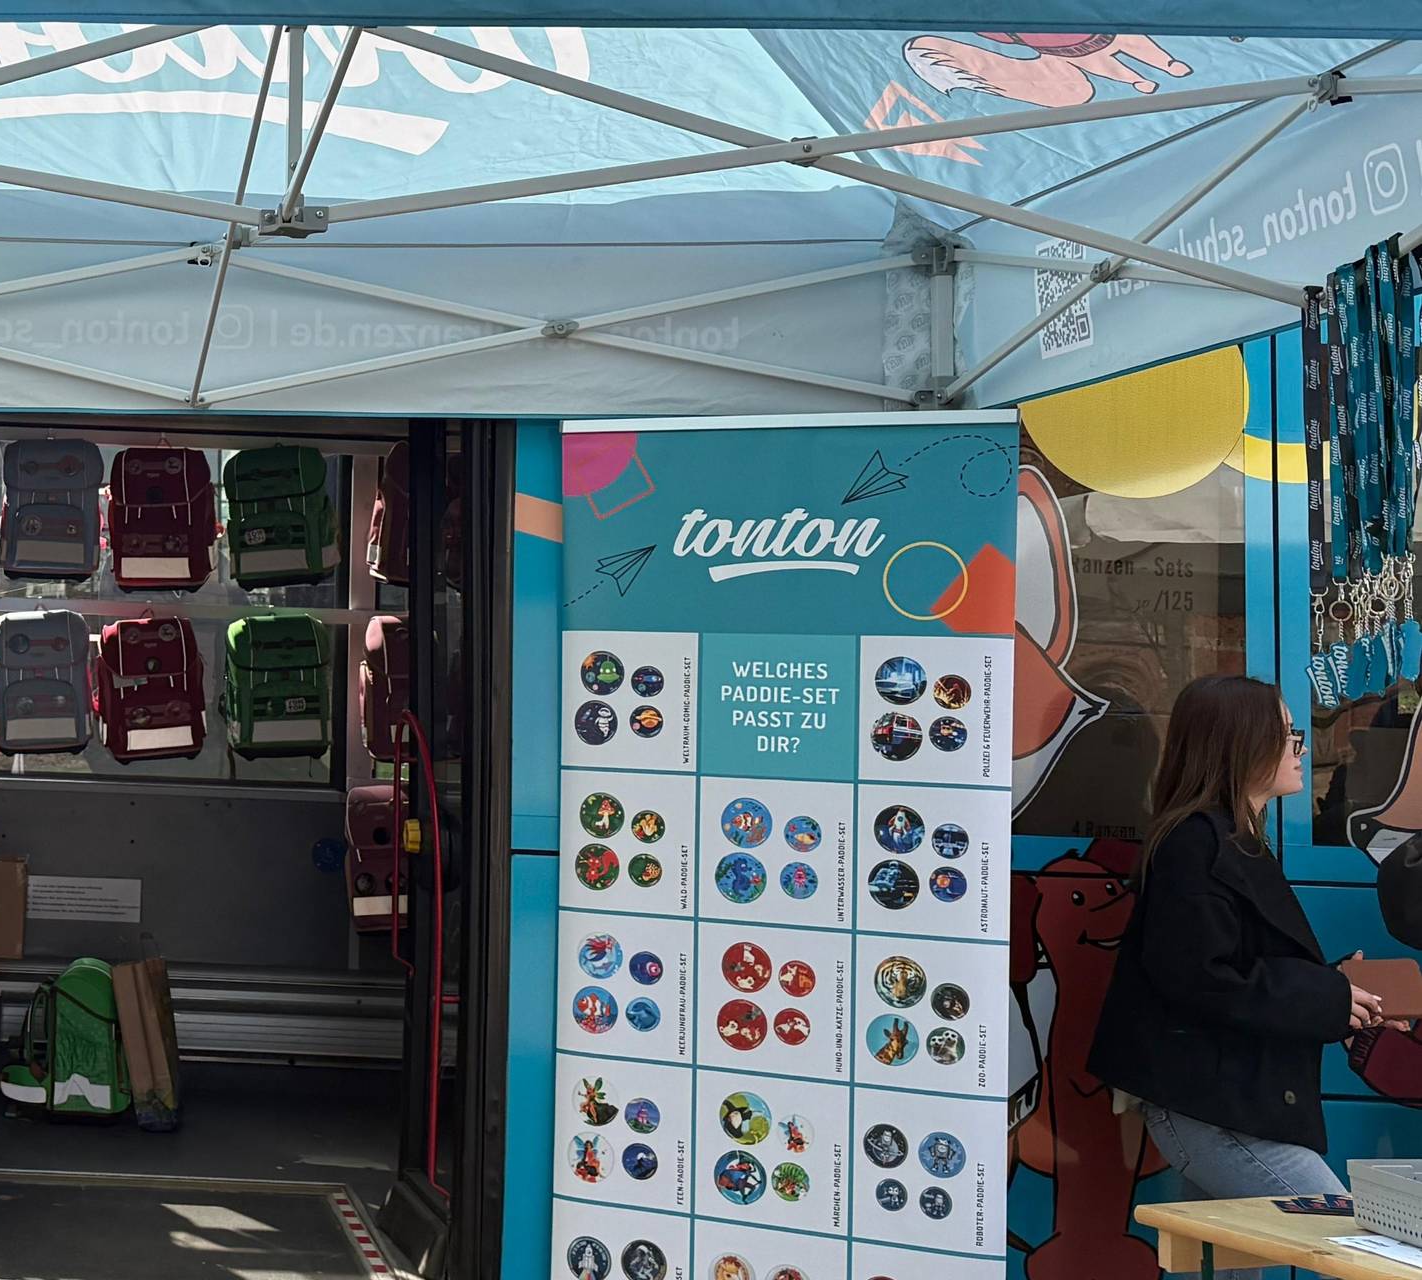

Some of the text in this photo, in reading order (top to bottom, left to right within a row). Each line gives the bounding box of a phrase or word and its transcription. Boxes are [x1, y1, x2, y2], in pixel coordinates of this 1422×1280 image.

[673, 508, 886, 557] tonton
[1154, 556, 1194, 578] Sets
[732, 661, 828, 680] WELCHES
[721, 685, 840, 705] PADDIE-SET
[732, 710, 826, 729] PASST ZU
[757, 736, 801, 753] DIR?
[978, 1024, 987, 1088] ZOO-PADDIE-SET
[976, 1163, 985, 1247] ROBOTER-PADDIE-SET
